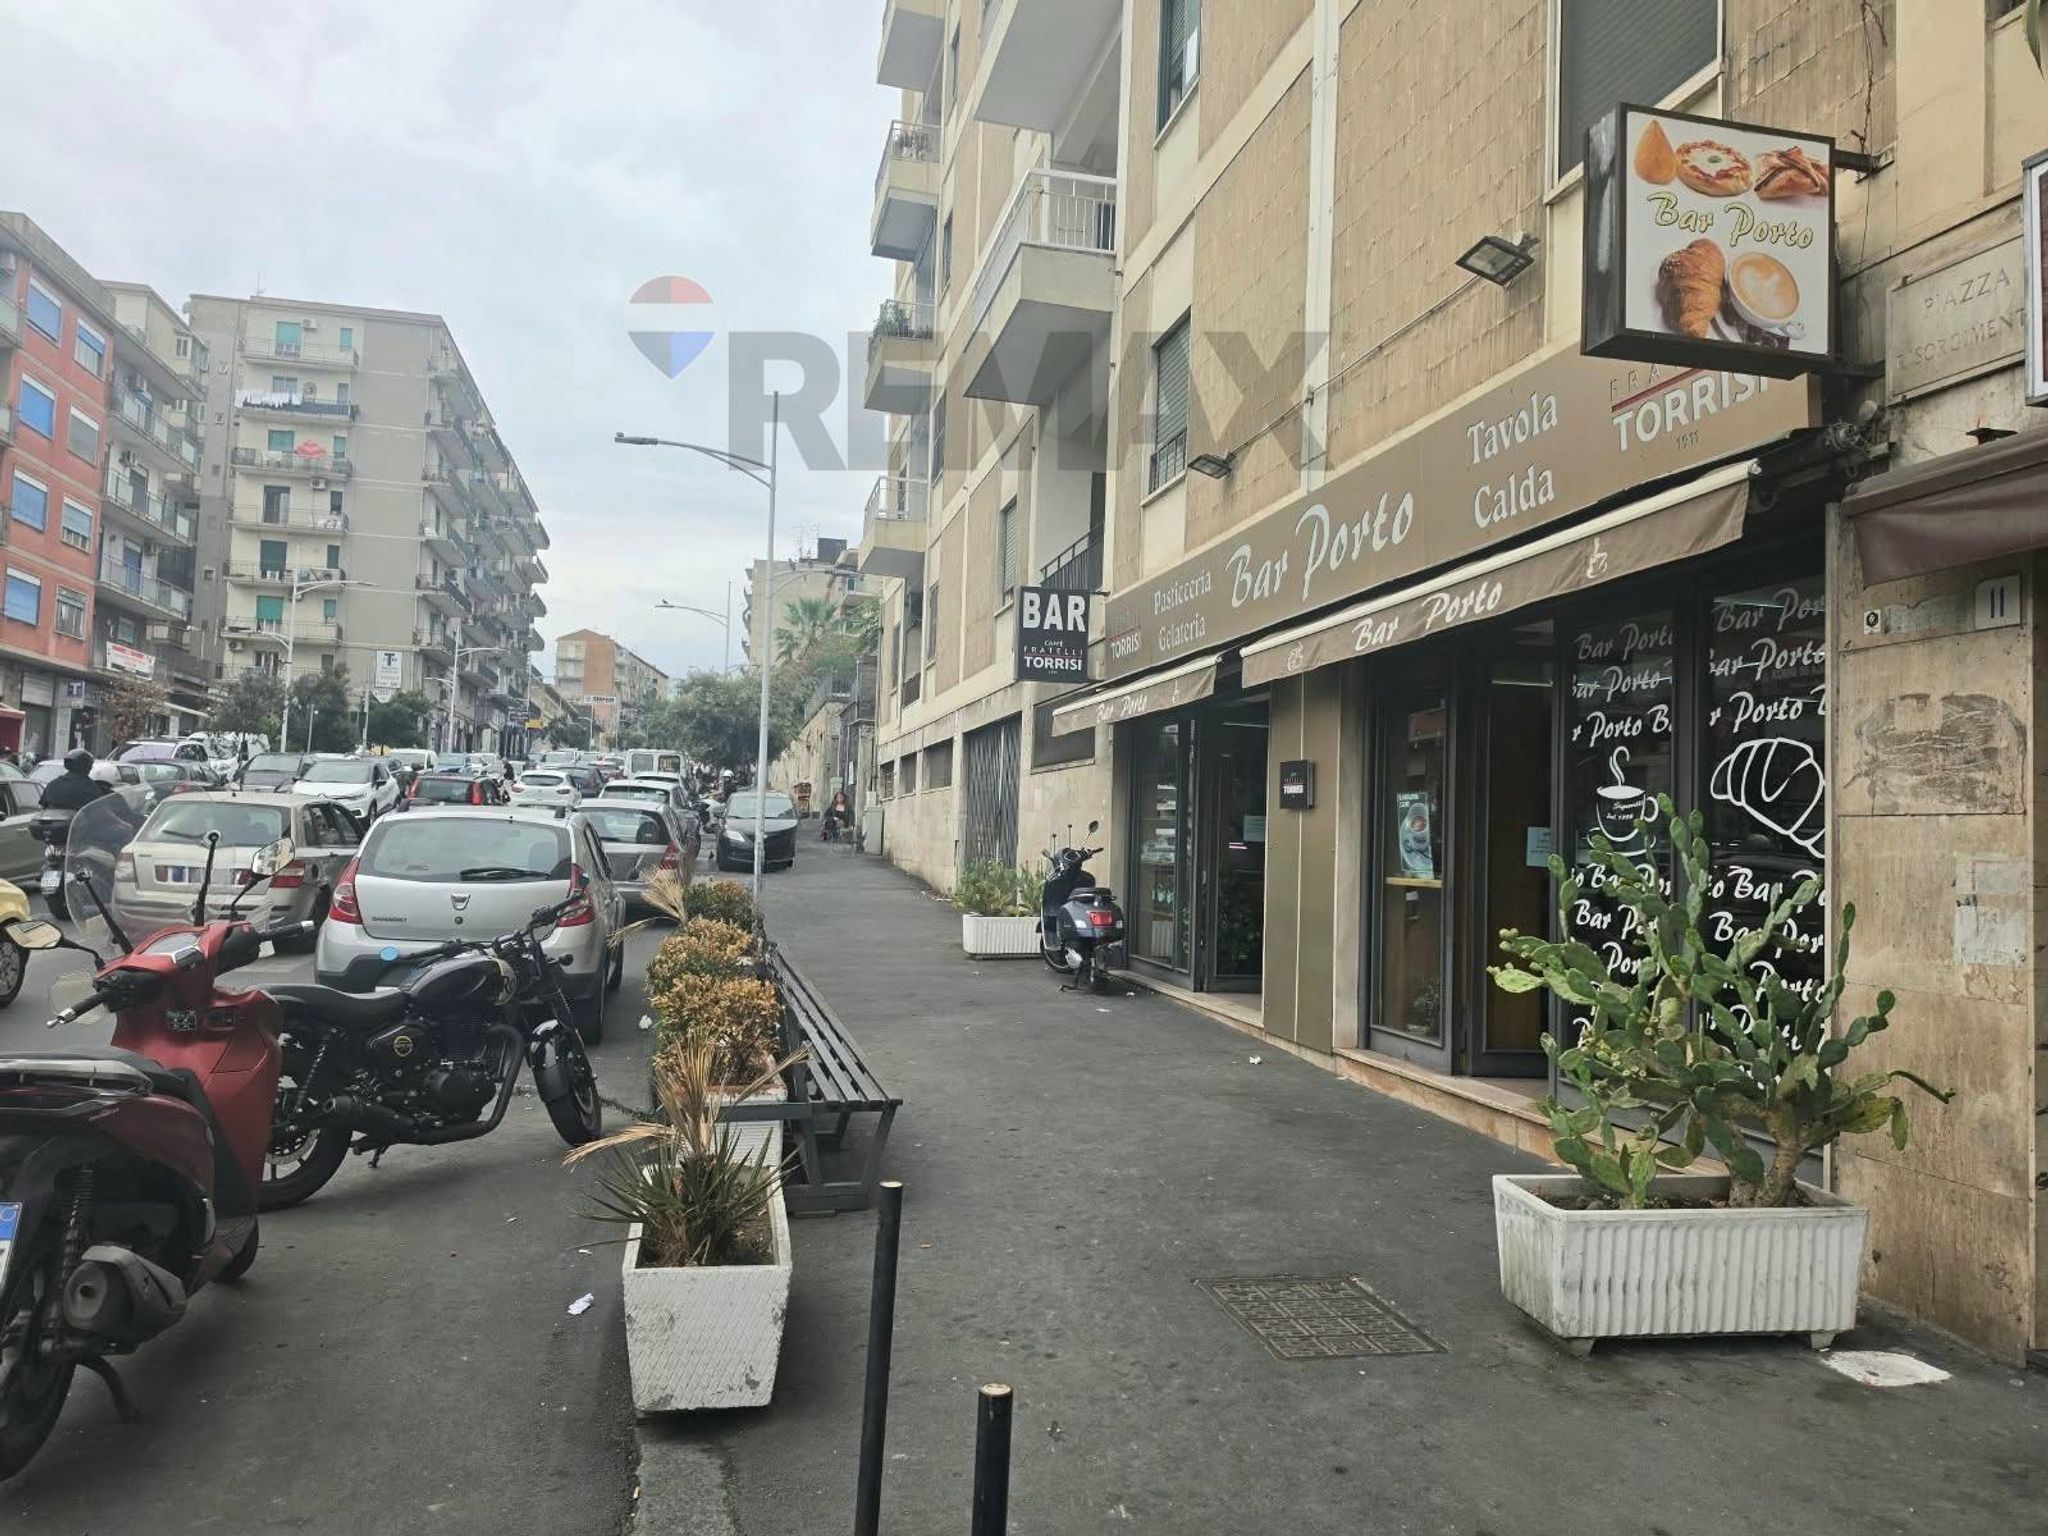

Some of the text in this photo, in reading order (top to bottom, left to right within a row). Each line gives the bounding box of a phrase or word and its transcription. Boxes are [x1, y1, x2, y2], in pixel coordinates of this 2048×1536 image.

[1647, 191, 1814, 249] Bar Porto
[1923, 266, 2011, 321] PIAZZA
[1466, 390, 1558, 465] Tavola
[1474, 464, 1555, 528] Calda
[1225, 491, 1414, 608] Bar Porto
[1023, 591, 1086, 633] BAR
[1154, 567, 1211, 615] Pasticceria
[1159, 612, 1206, 652] Gelateria
[1351, 581, 1502, 651] Bar Porto
[1711, 600, 1764, 633] Bar
[1023, 655, 1083, 671] TORRISI
[1573, 633, 1613, 660] Bar
[1603, 665, 1660, 702] Porto
[1586, 711, 1642, 747] Porto
[1729, 691, 1804, 733] Porto
[1574, 899, 1612, 930] Bar
